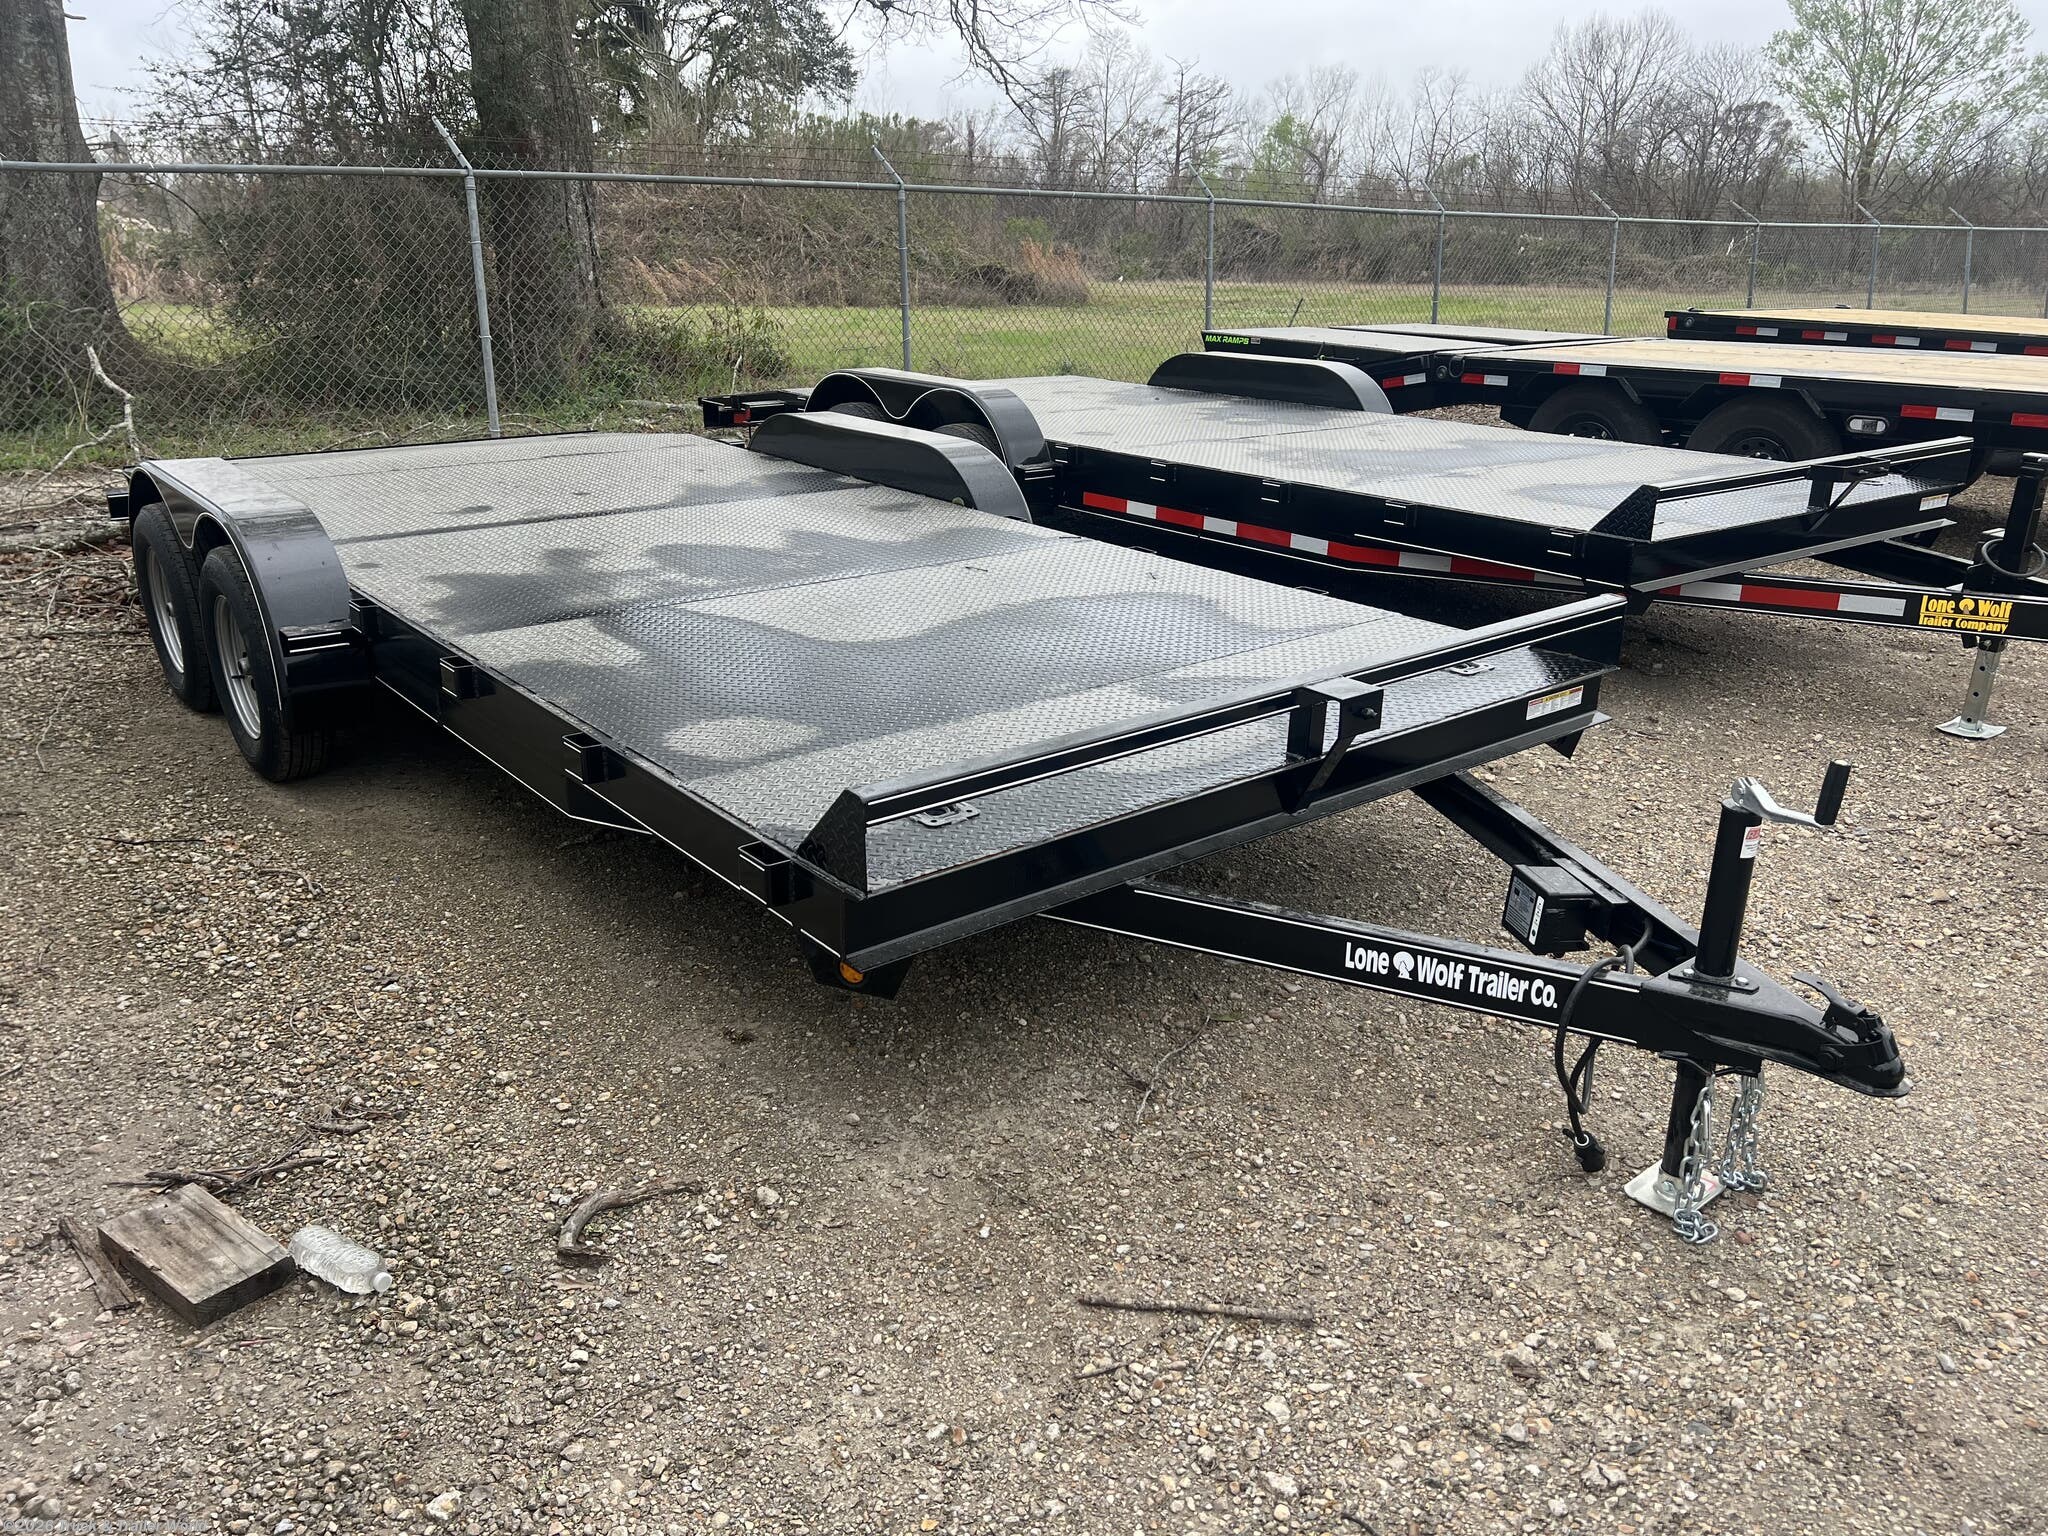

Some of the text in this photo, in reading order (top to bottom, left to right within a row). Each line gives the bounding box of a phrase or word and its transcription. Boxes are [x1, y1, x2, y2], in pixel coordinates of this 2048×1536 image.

[1222, 336, 1249, 344] RAMPS
[1920, 594, 2012, 618] Lone Wolf
[1919, 615, 2009, 634] Trailer Company
[1345, 942, 1558, 1008] Lone Wolf Trailer Co.
